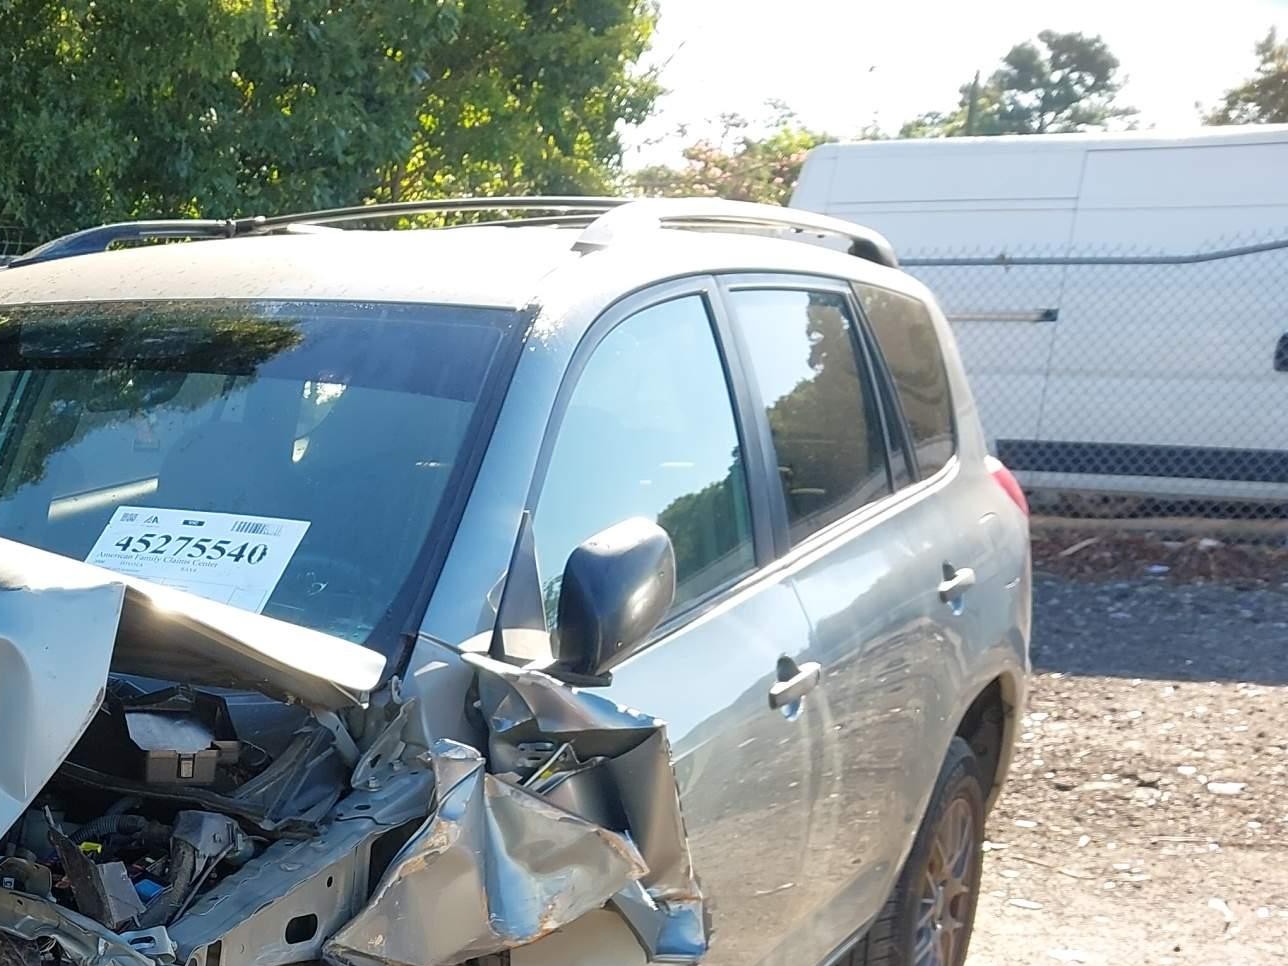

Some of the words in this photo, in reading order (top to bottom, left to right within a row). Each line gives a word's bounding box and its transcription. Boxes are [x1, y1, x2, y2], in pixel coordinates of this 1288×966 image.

[96, 551, 133, 560] American
[134, 553, 162, 564] Family
[163, 556, 191, 565] Claims
[192, 560, 219, 568] Center
[115, 533, 268, 566] 45275540
